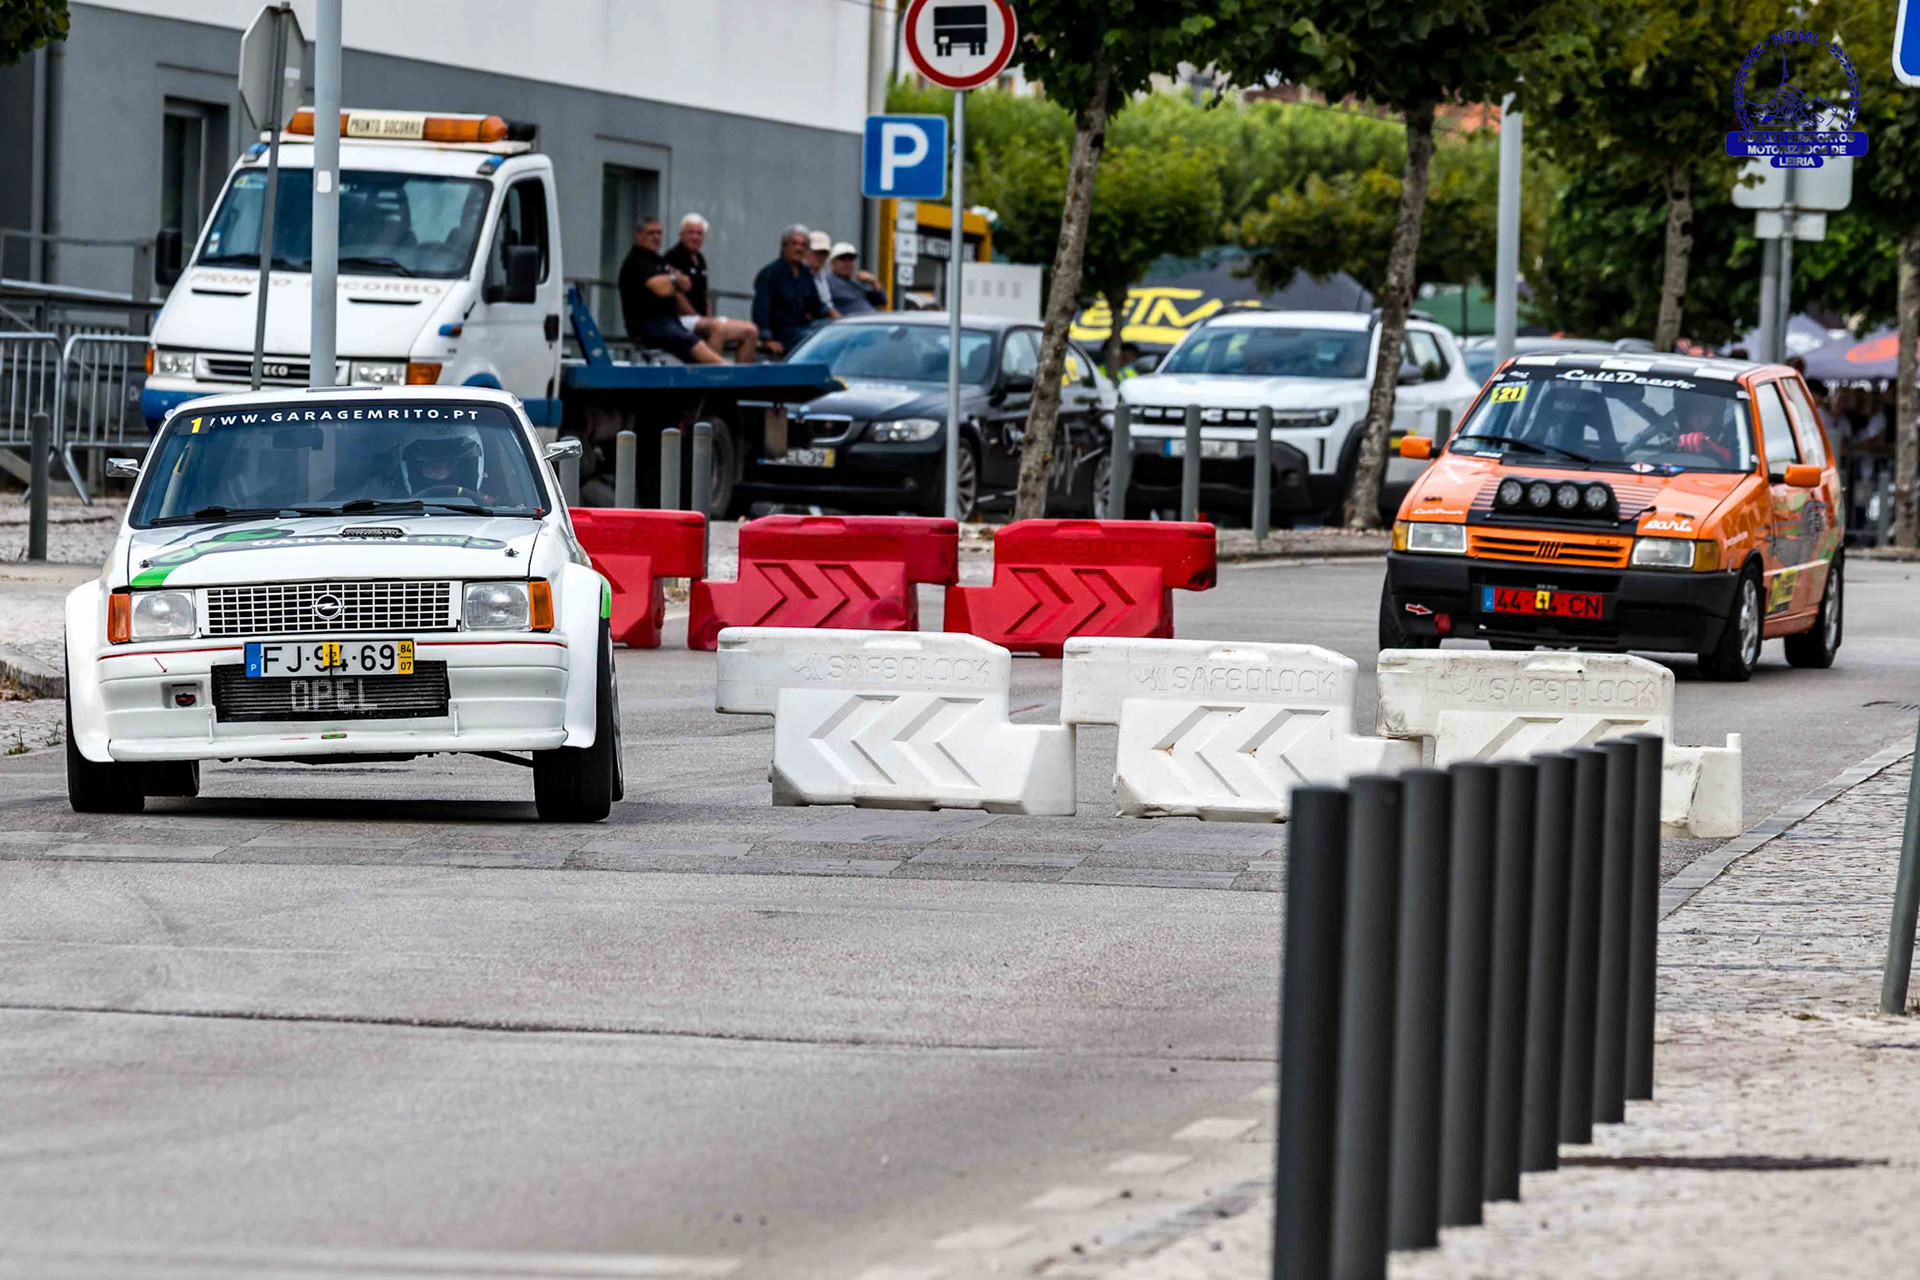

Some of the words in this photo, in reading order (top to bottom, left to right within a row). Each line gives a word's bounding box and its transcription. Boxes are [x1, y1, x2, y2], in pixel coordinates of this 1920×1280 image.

[350, 118, 380, 133] PRONTO
[383, 120, 421, 135] SOCORRO
[880, 122, 929, 191] P
[191, 272, 292, 288] PRONO
[190, 416, 203, 434] 1
[400, 644, 411, 653] 84
[400, 661, 412, 671] 07
[290, 679, 378, 712] OPEL
